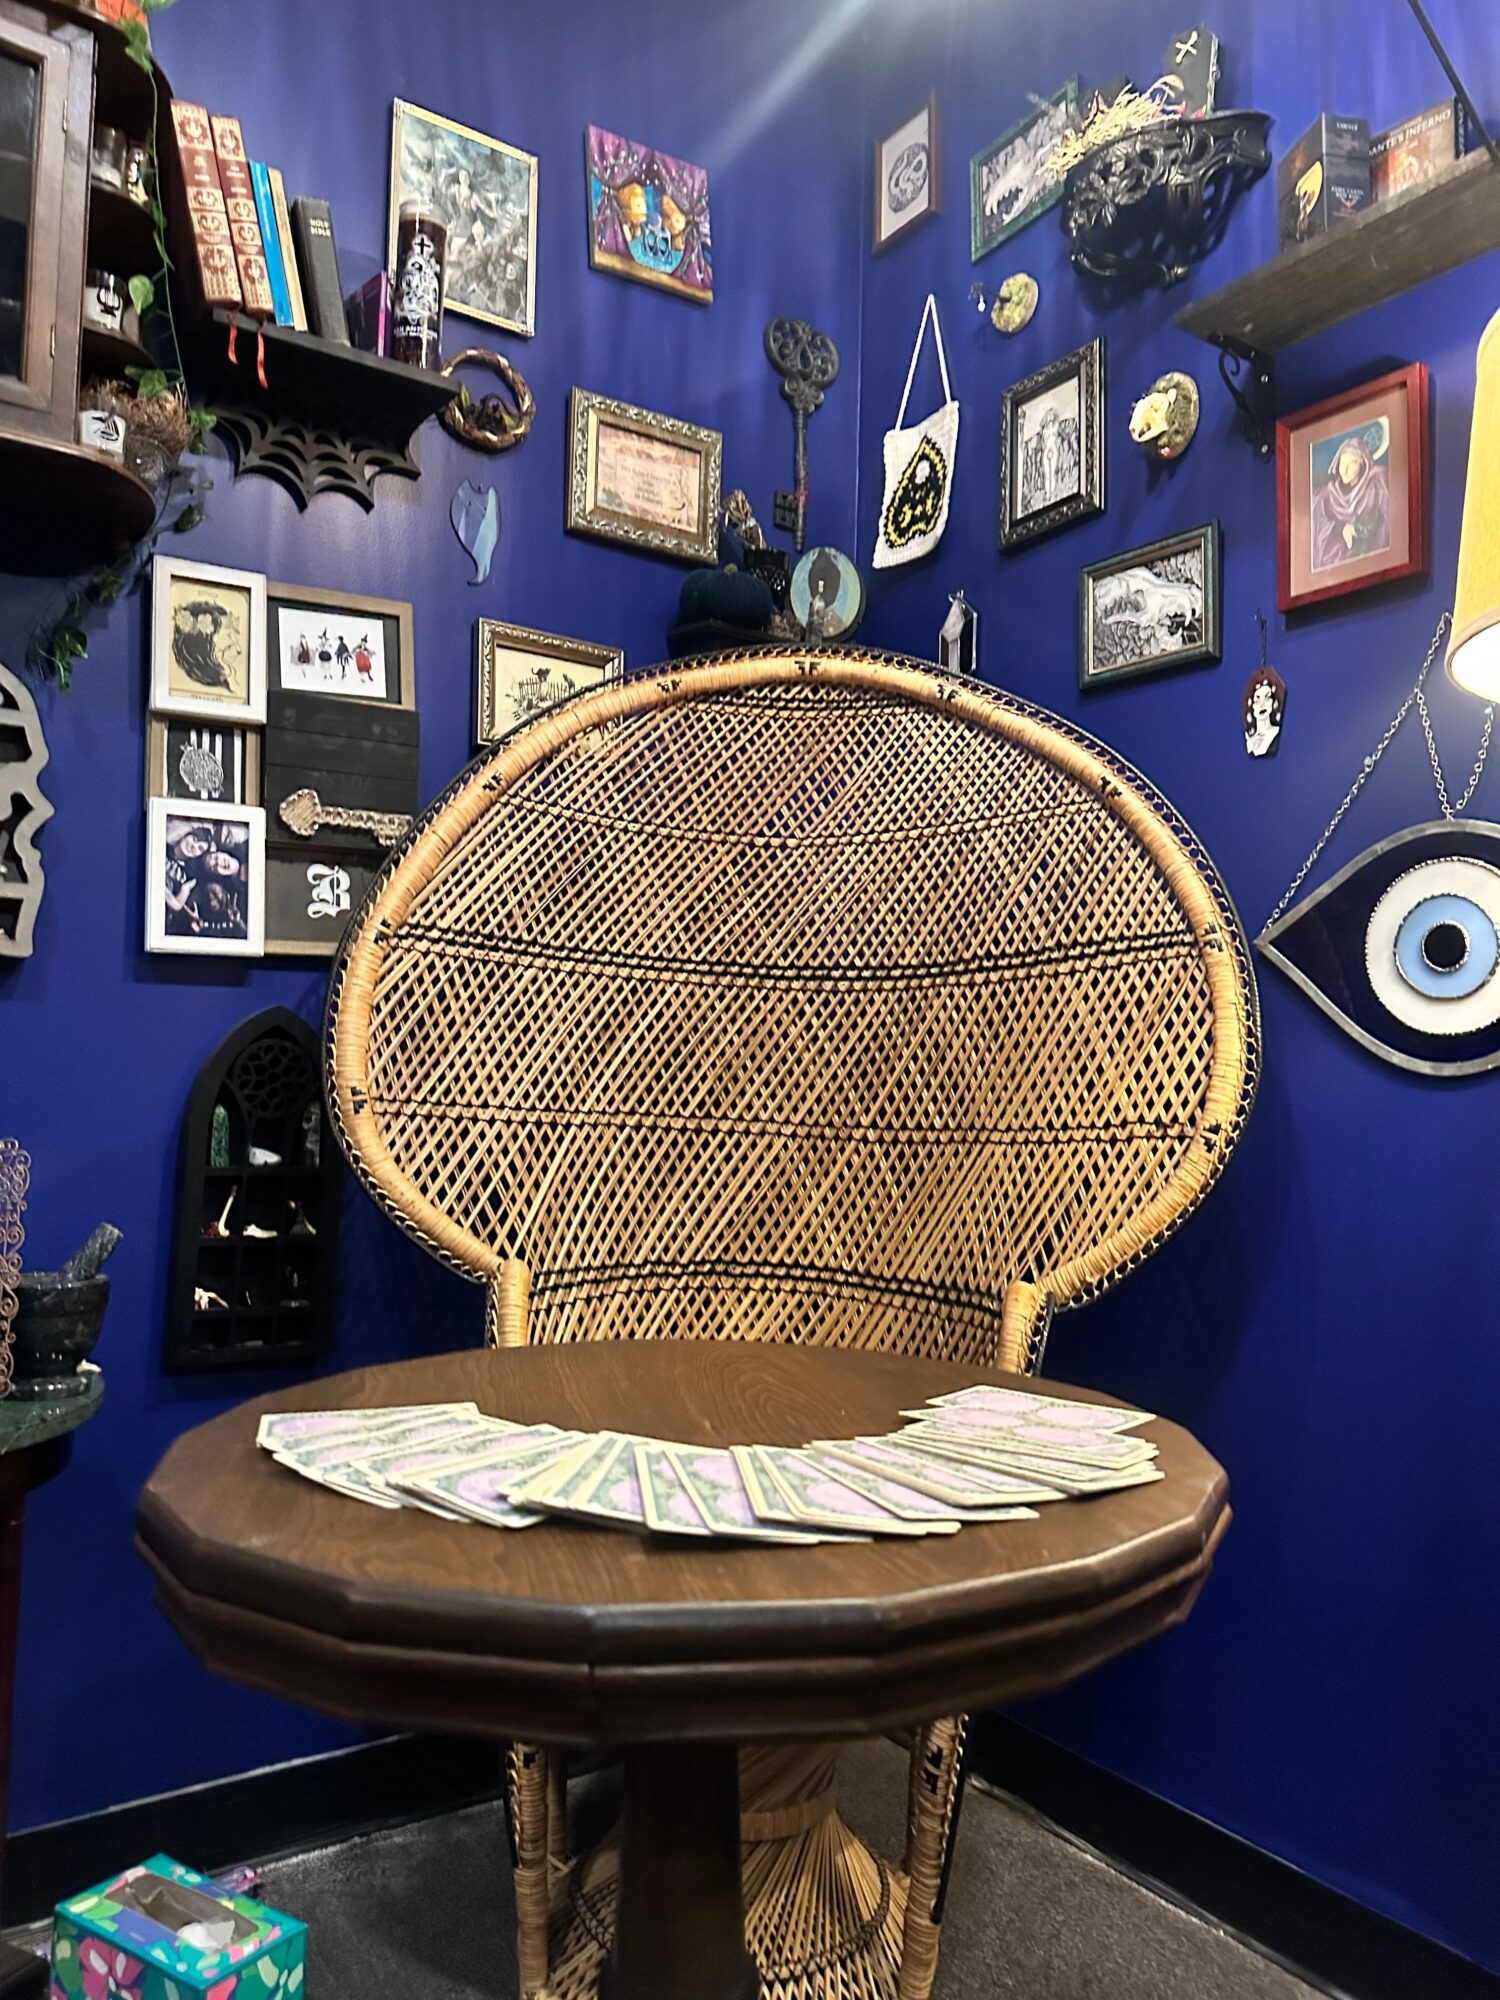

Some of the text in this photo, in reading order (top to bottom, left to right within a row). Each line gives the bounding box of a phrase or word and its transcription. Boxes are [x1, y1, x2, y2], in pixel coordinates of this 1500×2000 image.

[1369, 132, 1405, 156] ANTE'S
[1405, 108, 1452, 138] INFERNO
[310, 218, 329, 229] HOLY
